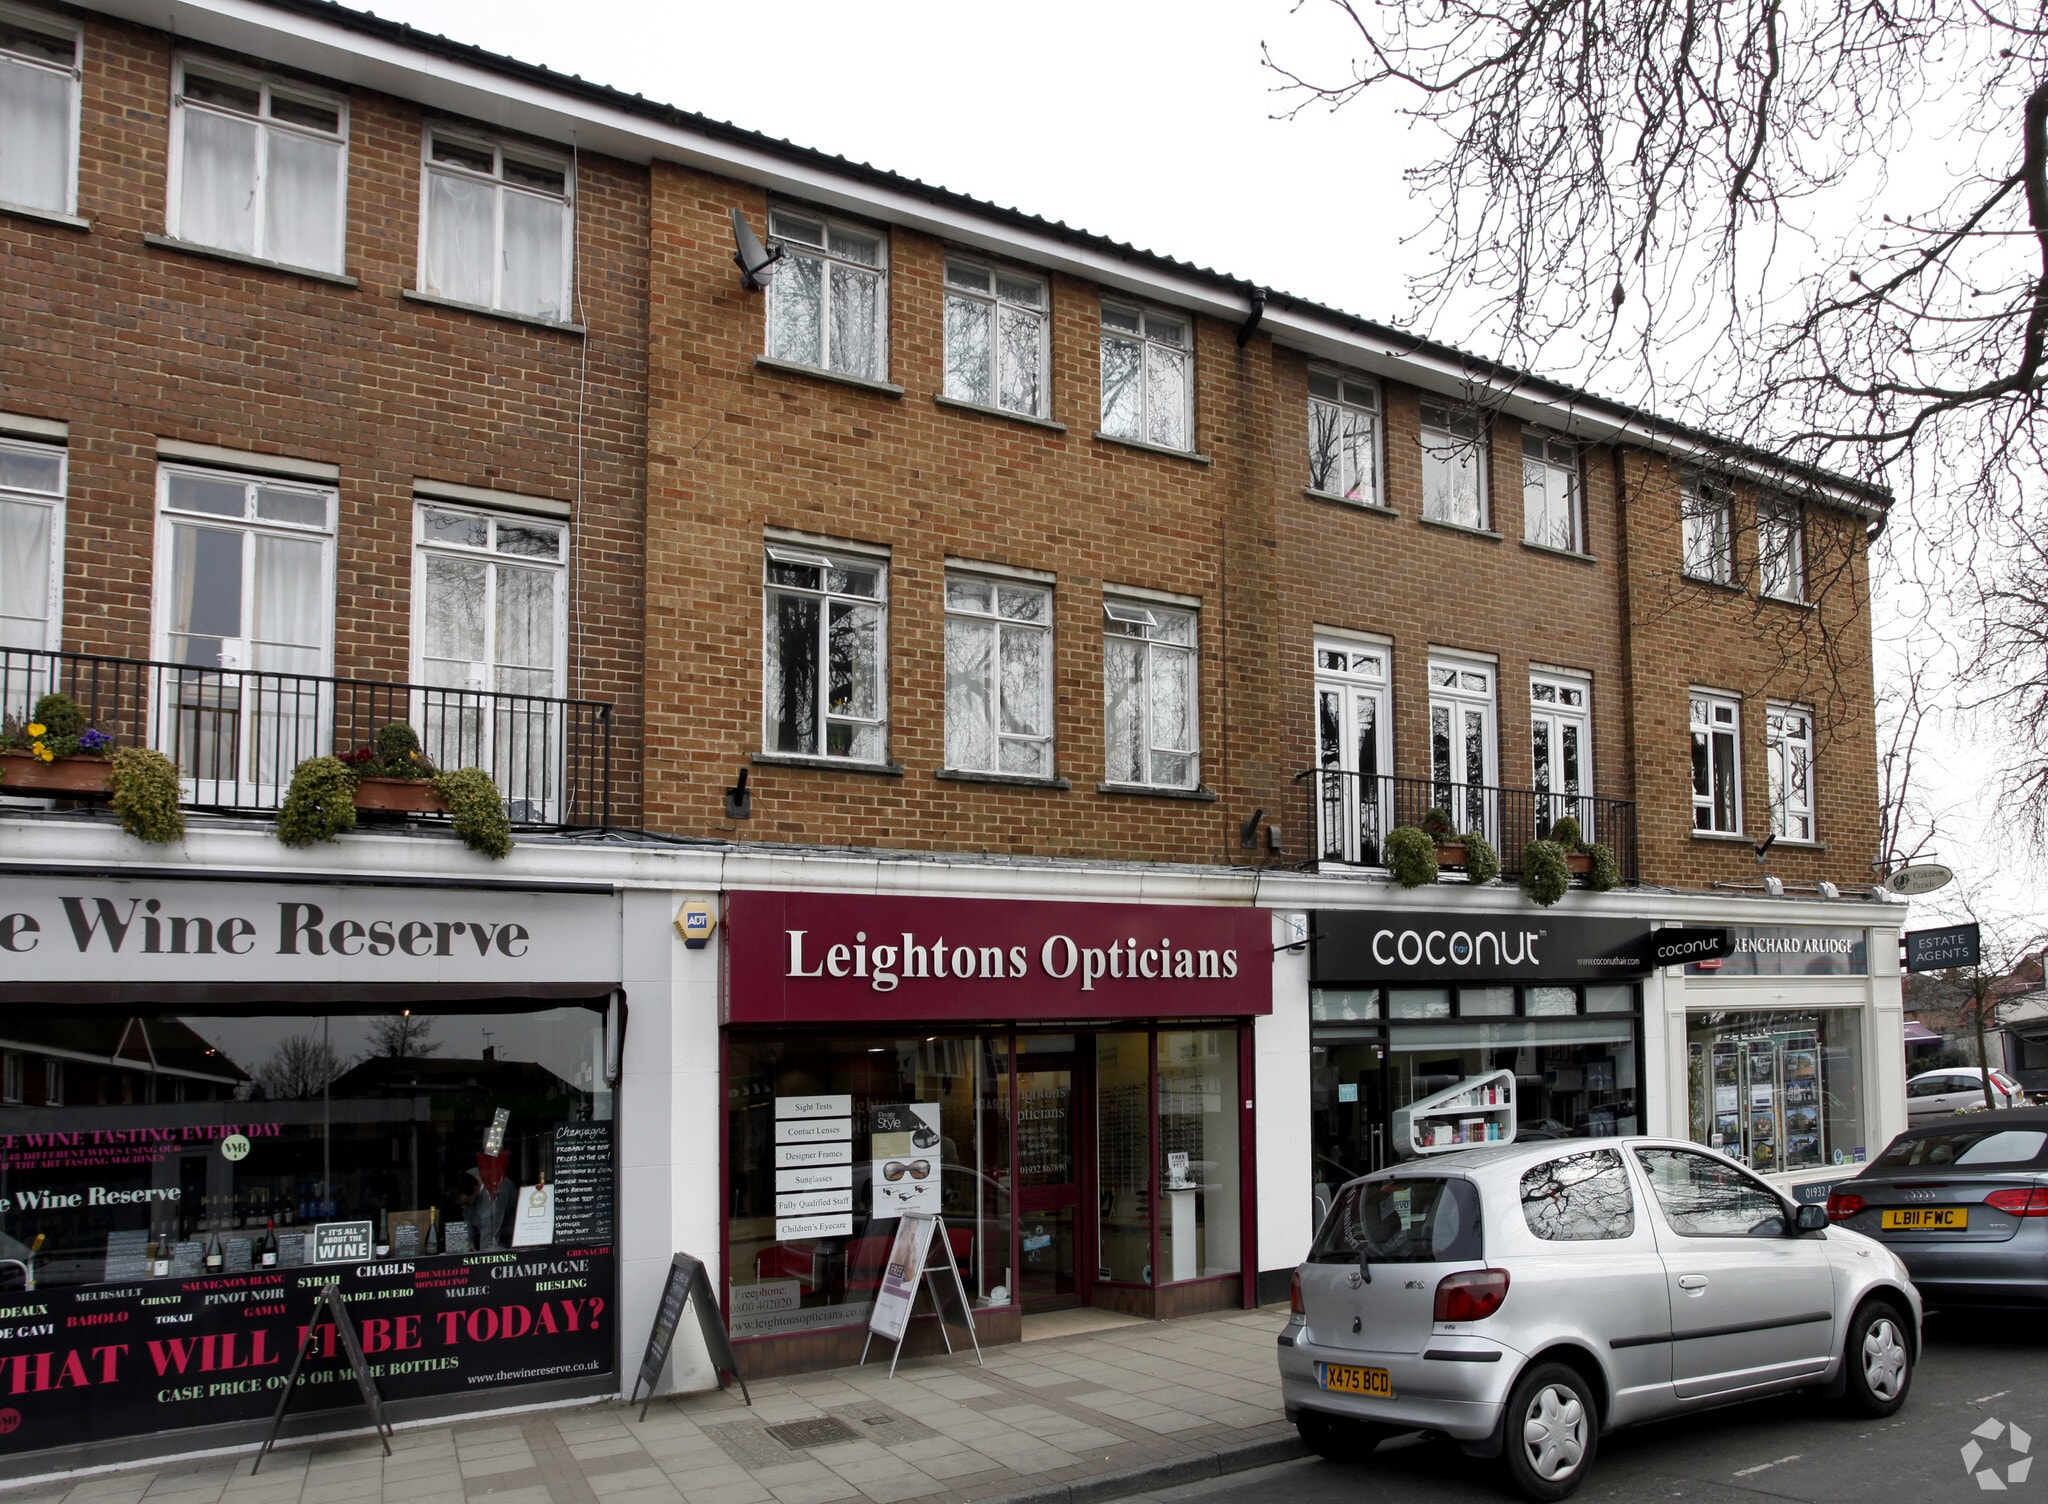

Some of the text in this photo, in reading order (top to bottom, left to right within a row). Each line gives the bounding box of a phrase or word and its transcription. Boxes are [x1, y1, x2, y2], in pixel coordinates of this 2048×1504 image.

[1913, 870, 1945, 879] Oakdene
[1913, 881, 1936, 889] Parade
[58, 896, 256, 954] Wine
[276, 902, 529, 957] Reserve
[687, 915, 707, 925] ADT
[1372, 929, 1540, 966] coconut
[1658, 938, 1718, 957] coconut
[1734, 938, 1853, 953] RENCHARD ARLIDGE
[1918, 933, 1965, 949] ESTATE
[785, 930, 1027, 992] Leightons
[1041, 934, 1238, 991] Opticians
[1577, 956, 1640, 966] www.coconuthair.com
[1915, 946, 1969, 962] AGENTS
[795, 1102, 832, 1112] Sight Tests
[877, 1117, 901, 1130] Style
[25, 1132, 86, 1148] WINE
[93, 1127, 176, 1145] TASTING
[182, 1124, 244, 1141] EVERY
[250, 1123, 283, 1137] DAY
[556, 1126, 608, 1140] Champagne
[788, 1126, 840, 1136] Contact Lenses
[23, 1149, 85, 1160] DIFFERENT
[87, 1146, 122, 1157] WINES
[785, 1150, 843, 1161] Designer Frames
[40, 1159, 61, 1169] ART
[63, 1157, 109, 1167] TASTING
[111, 1154, 165, 1164] MACHINES
[795, 1176, 833, 1185] Sunglasses
[16, 1190, 82, 1210] Wine
[88, 1186, 181, 1206] Reserve
[1805, 1186, 1826, 1198] 01932
[779, 1197, 849, 1210] Fully Qualified Staff
[1893, 1211, 1954, 1225] LB11 FWC
[328, 1228, 343, 1236] IT'S
[782, 1222, 846, 1233] Children's Eyecare
[323, 1236, 347, 1244] ABOUT
[318, 1243, 367, 1259] WINE
[463, 1254, 517, 1266] SAUTERNES
[356, 1262, 415, 1278] CHABLIS
[415, 1267, 470, 1279] BRUNELLO DI
[490, 1259, 589, 1280] CHAMPAGNE
[182, 1274, 286, 1291] SAUVIGNON BLANC
[297, 1275, 341, 1288] SYRAH
[415, 1278, 468, 1289] MONTALCINO
[536, 1278, 587, 1292] RIESLING
[75, 1287, 143, 1302] MEURSAULT
[204, 1288, 284, 1306] PINOT NOIR
[354, 1291, 376, 1302] DEL
[378, 1288, 414, 1300] DUERO
[445, 1286, 490, 1298] MALBEC
[735, 1286, 787, 1300] Freephone:
[141, 1295, 182, 1306] CHIANTI
[756, 1298, 792, 1310] 402020
[244, 1304, 287, 1317] GAMAY
[66, 1312, 129, 1327] BAROLO
[155, 1313, 193, 1324] TOKAJI
[17, 1324, 54, 1337] GAVI
[146, 1329, 279, 1377] WILL
[360, 1315, 422, 1354] BE
[437, 1297, 604, 1346] TODAY?
[467, 1359, 599, 1385] www.thewinereserve.co.uk
[158, 1384, 204, 1403] CASE
[209, 1379, 262, 1397] PRICE
[267, 1375, 291, 1391] ON
[296, 1373, 305, 1387] 6
[310, 1370, 333, 1384] OR
[390, 1356, 459, 1376] BOTTLES
[1329, 1367, 1389, 1392] X475 BCD
